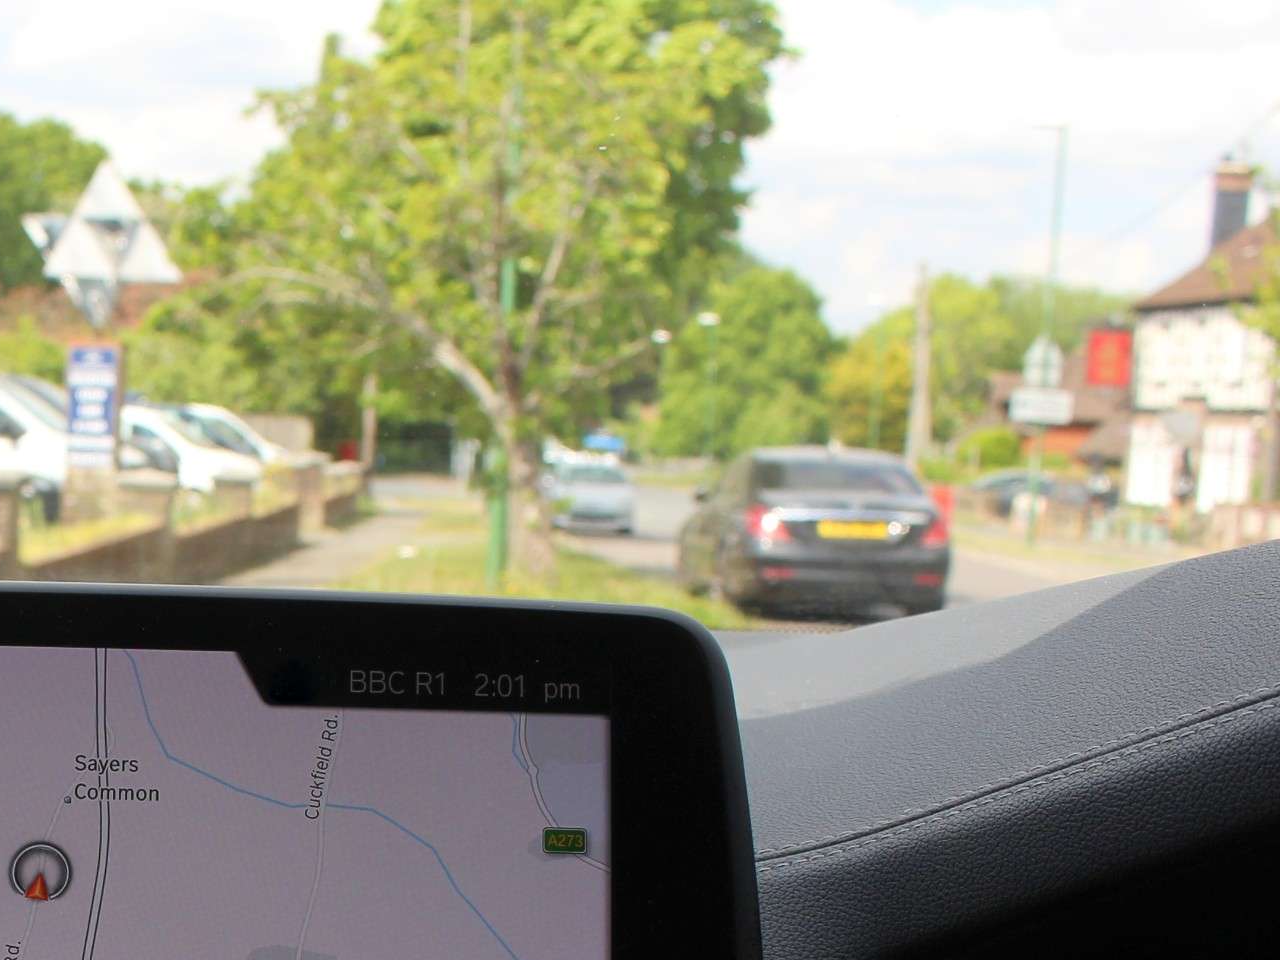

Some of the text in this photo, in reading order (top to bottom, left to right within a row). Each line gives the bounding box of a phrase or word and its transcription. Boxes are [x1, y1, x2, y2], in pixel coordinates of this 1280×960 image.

[349, 670, 581, 701] BBC R1 2:01 pm
[75, 754, 139, 775] Sayers
[304, 713, 339, 820] Cuckfield Rd.
[74, 783, 160, 802] Common
[548, 834, 584, 848] A273
